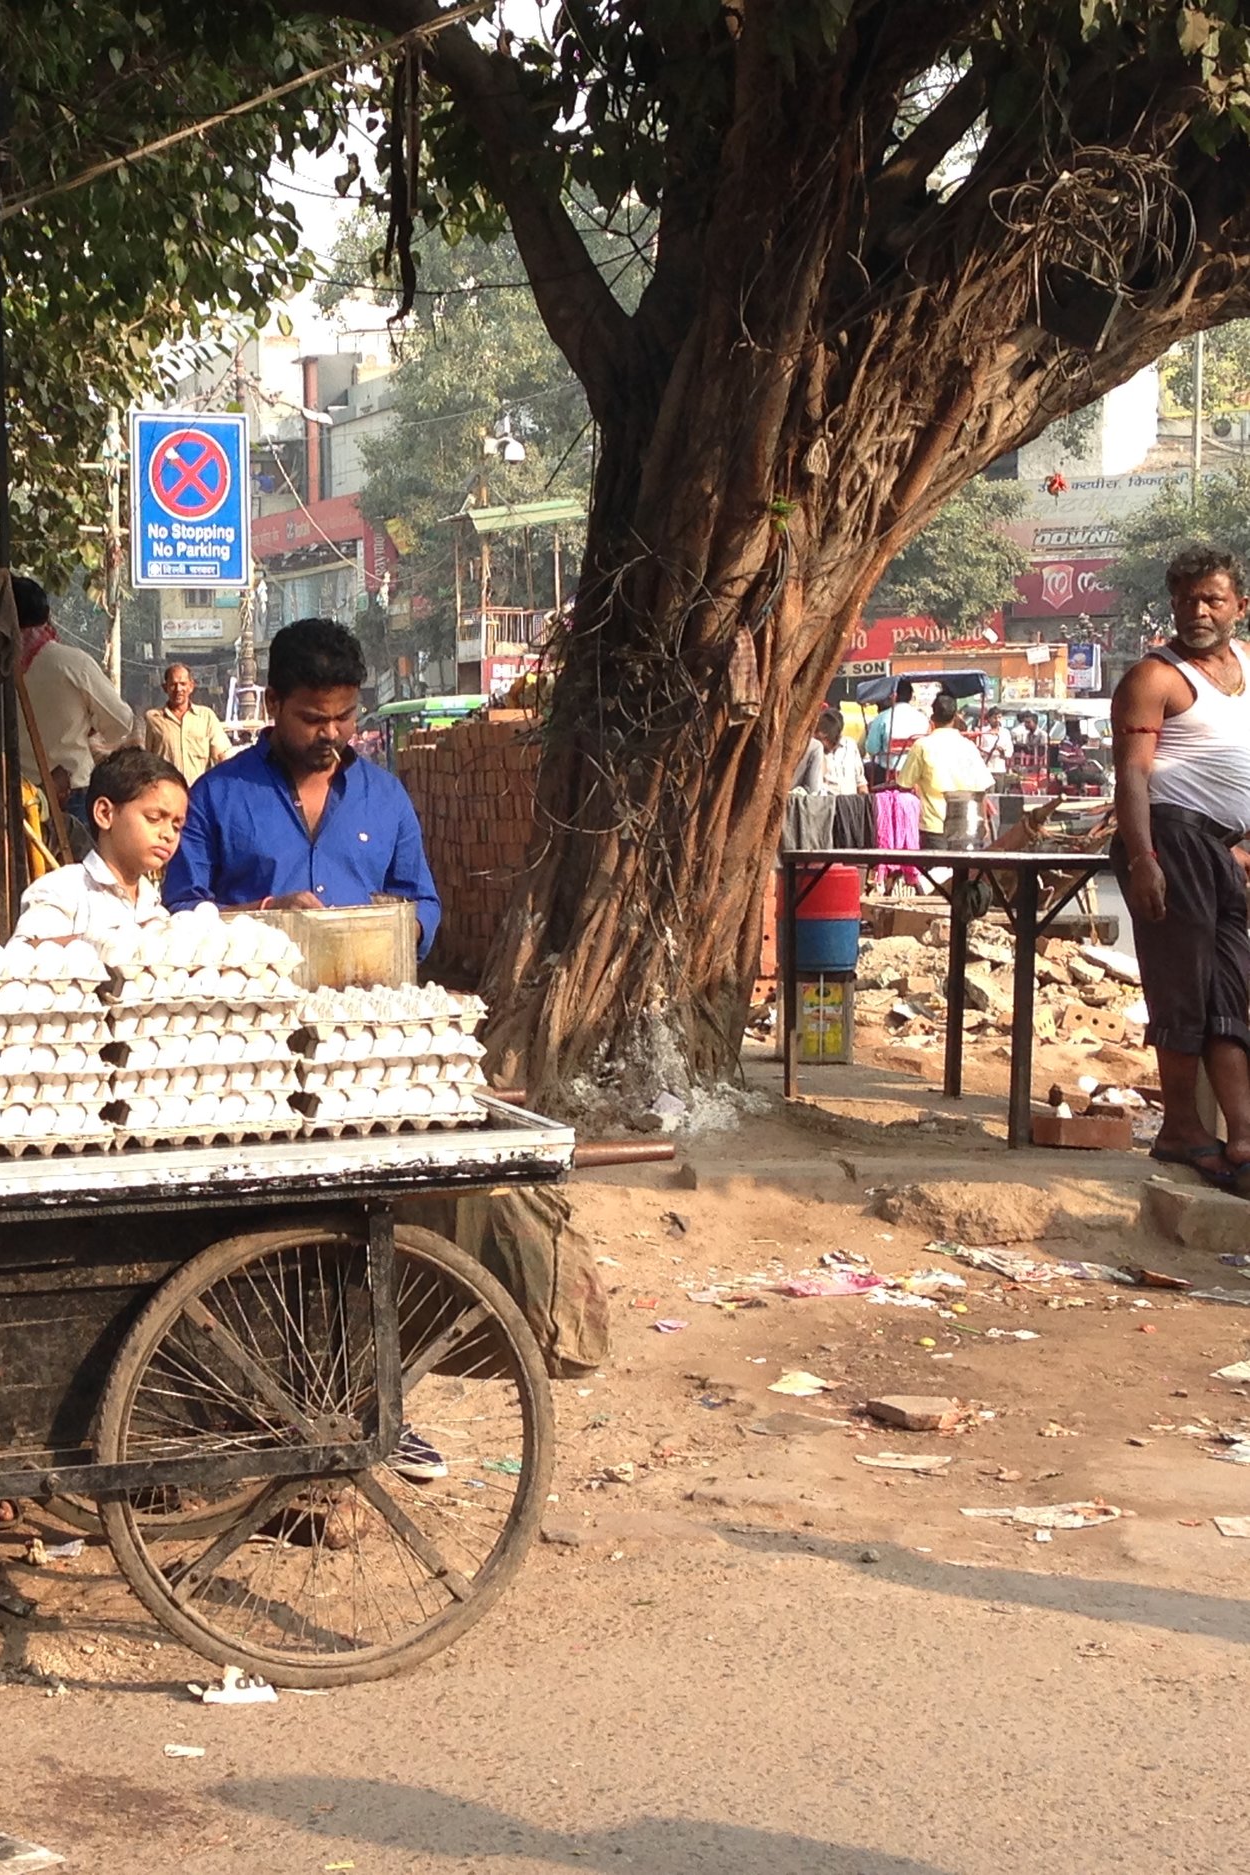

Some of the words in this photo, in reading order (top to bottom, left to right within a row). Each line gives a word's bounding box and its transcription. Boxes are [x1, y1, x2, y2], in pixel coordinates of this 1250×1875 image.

[147, 523, 168, 539] No
[171, 523, 235, 543] Stopping
[153, 541, 173, 558] No
[176, 541, 230, 561] Parking
